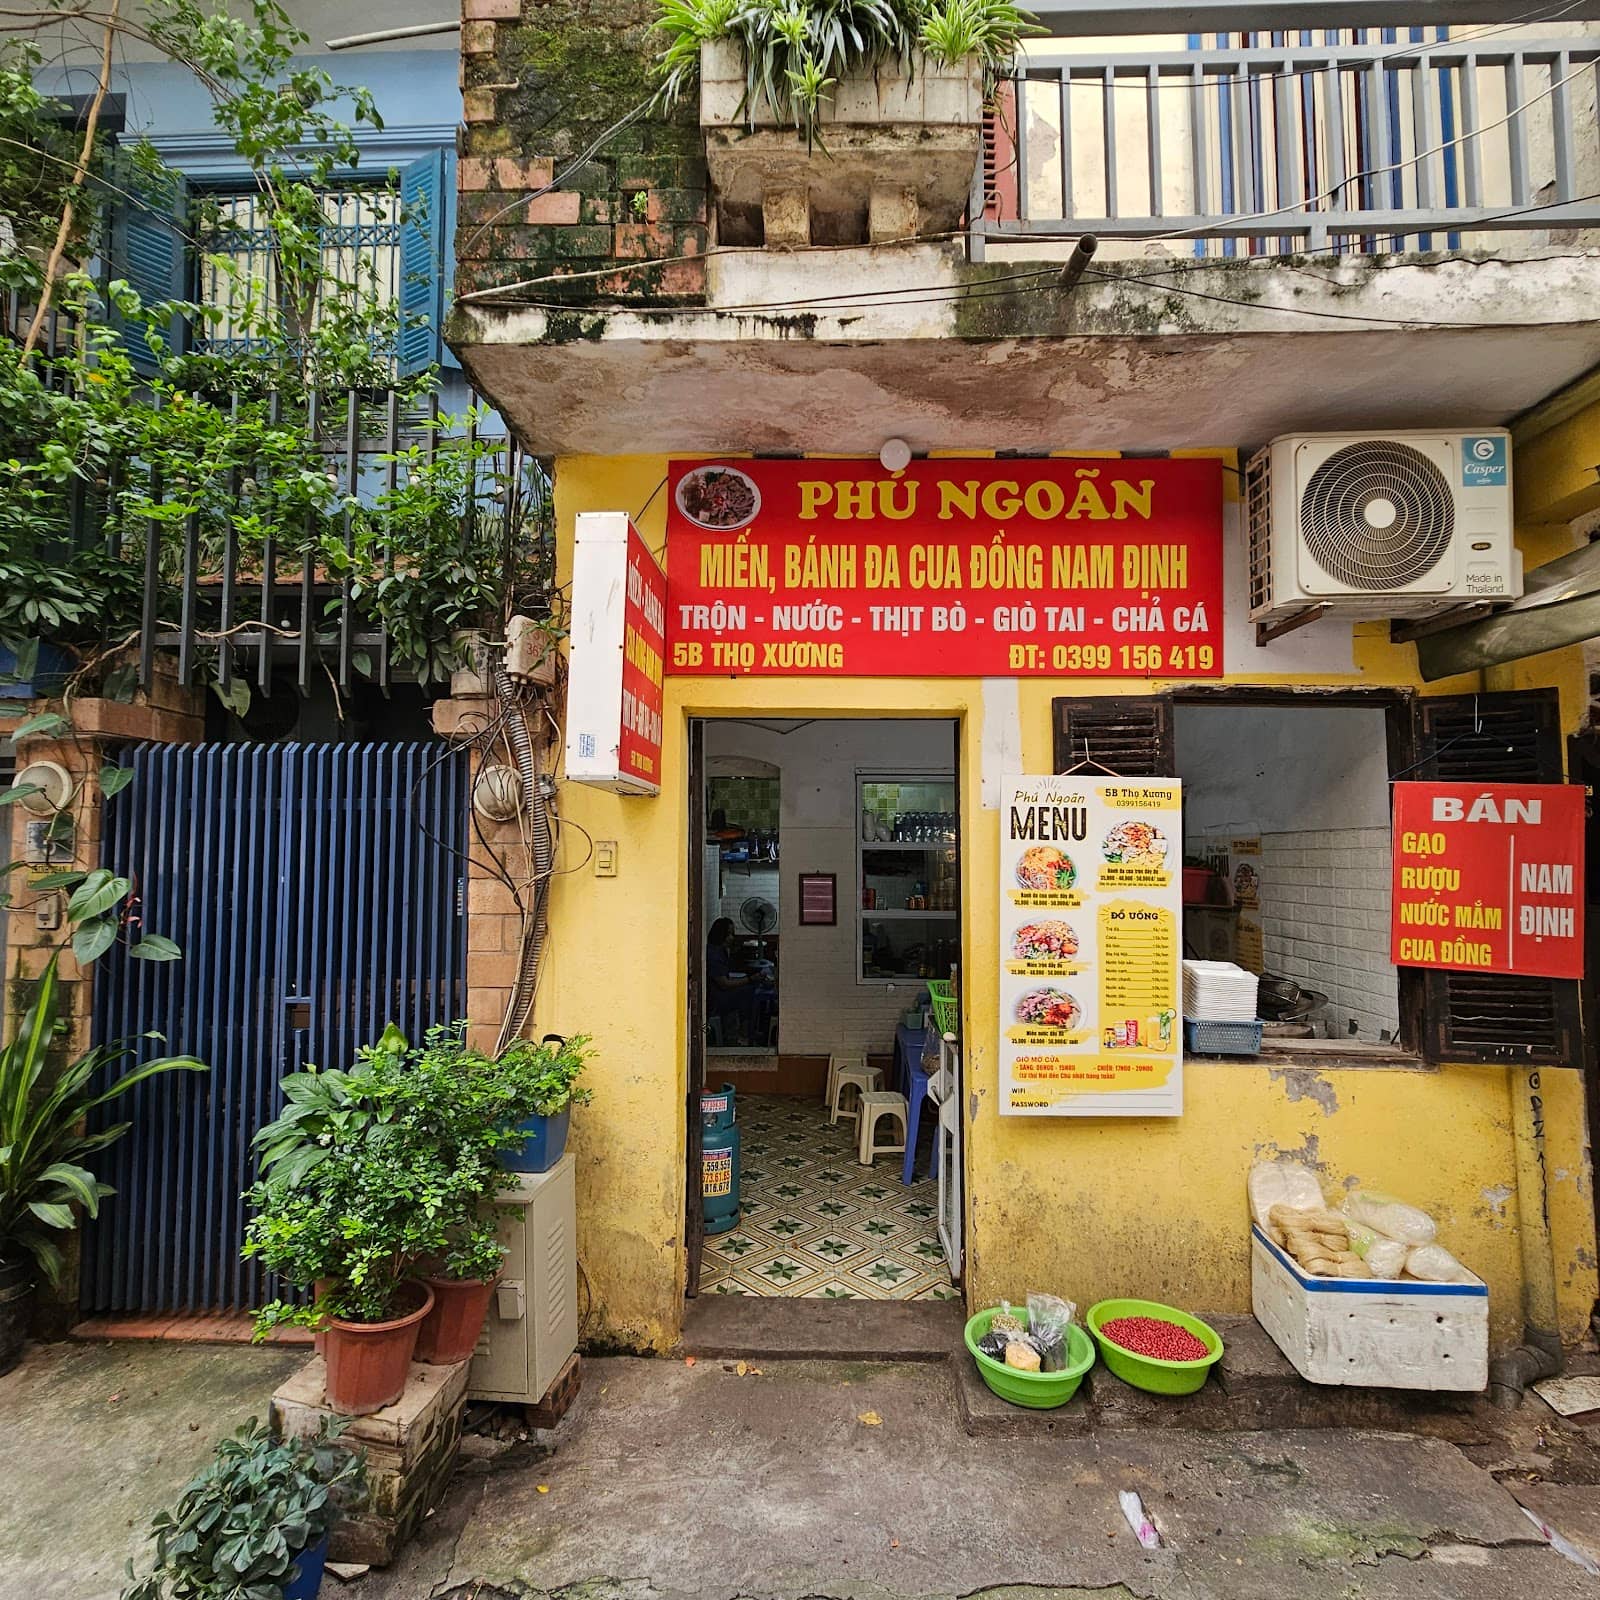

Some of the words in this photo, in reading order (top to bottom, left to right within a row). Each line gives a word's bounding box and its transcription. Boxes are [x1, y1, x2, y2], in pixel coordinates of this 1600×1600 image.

[1464, 463, 1504, 478] Casper
[798, 469, 920, 520] PHÚ
[936, 468, 1156, 520] NGOÃN
[700, 528, 776, 594] MIẾN,
[784, 535, 857, 589] BÁNH
[864, 544, 901, 589] ĐA
[909, 544, 962, 589] CUA
[970, 529, 1043, 590] ĐỒNG
[1052, 544, 1114, 589] NAM
[1122, 544, 1188, 600] ĐỊNH
[1466, 573, 1491, 583] Made
[1494, 573, 1502, 583] in
[1466, 583, 1504, 593] Thailand
[679, 599, 746, 636] TRỘN
[772, 598, 843, 632] NƯỚC
[869, 606, 924, 637] THỊT
[931, 600, 966, 632] BÒ
[993, 601, 1037, 632] GIÒ
[1044, 606, 1085, 632] TAI
[1112, 596, 1165, 632] CHẢ
[1173, 602, 1208, 632] CÁ
[673, 643, 703, 667] 5B
[710, 643, 755, 672] THỌ
[762, 641, 843, 668] XƯƠNG
[1009, 644, 1046, 669] ĐT:
[1052, 645, 1111, 670] 0399
[1119, 645, 1162, 670] 156
[1168, 645, 1214, 670] 419
[1014, 790, 1038, 804] Phú
[1045, 792, 1085, 806] Ngoãn
[1105, 788, 1118, 797] 5B
[1121, 789, 1139, 798] Thọ
[1116, 800, 1161, 808] 0399156419
[1010, 806, 1087, 841] MENU
[1431, 792, 1542, 825] BÁN
[1402, 832, 1446, 859] GẠO
[1401, 866, 1461, 895] RƯỢU
[1520, 863, 1573, 894] NAM
[1129, 908, 1159, 920] UỐNG
[1400, 898, 1449, 927] NƯỚC
[1455, 899, 1502, 930] MẮM
[1520, 905, 1575, 943] ĐỊNH
[1400, 938, 1436, 962] CUA
[1440, 934, 1492, 966] ĐỒNG
